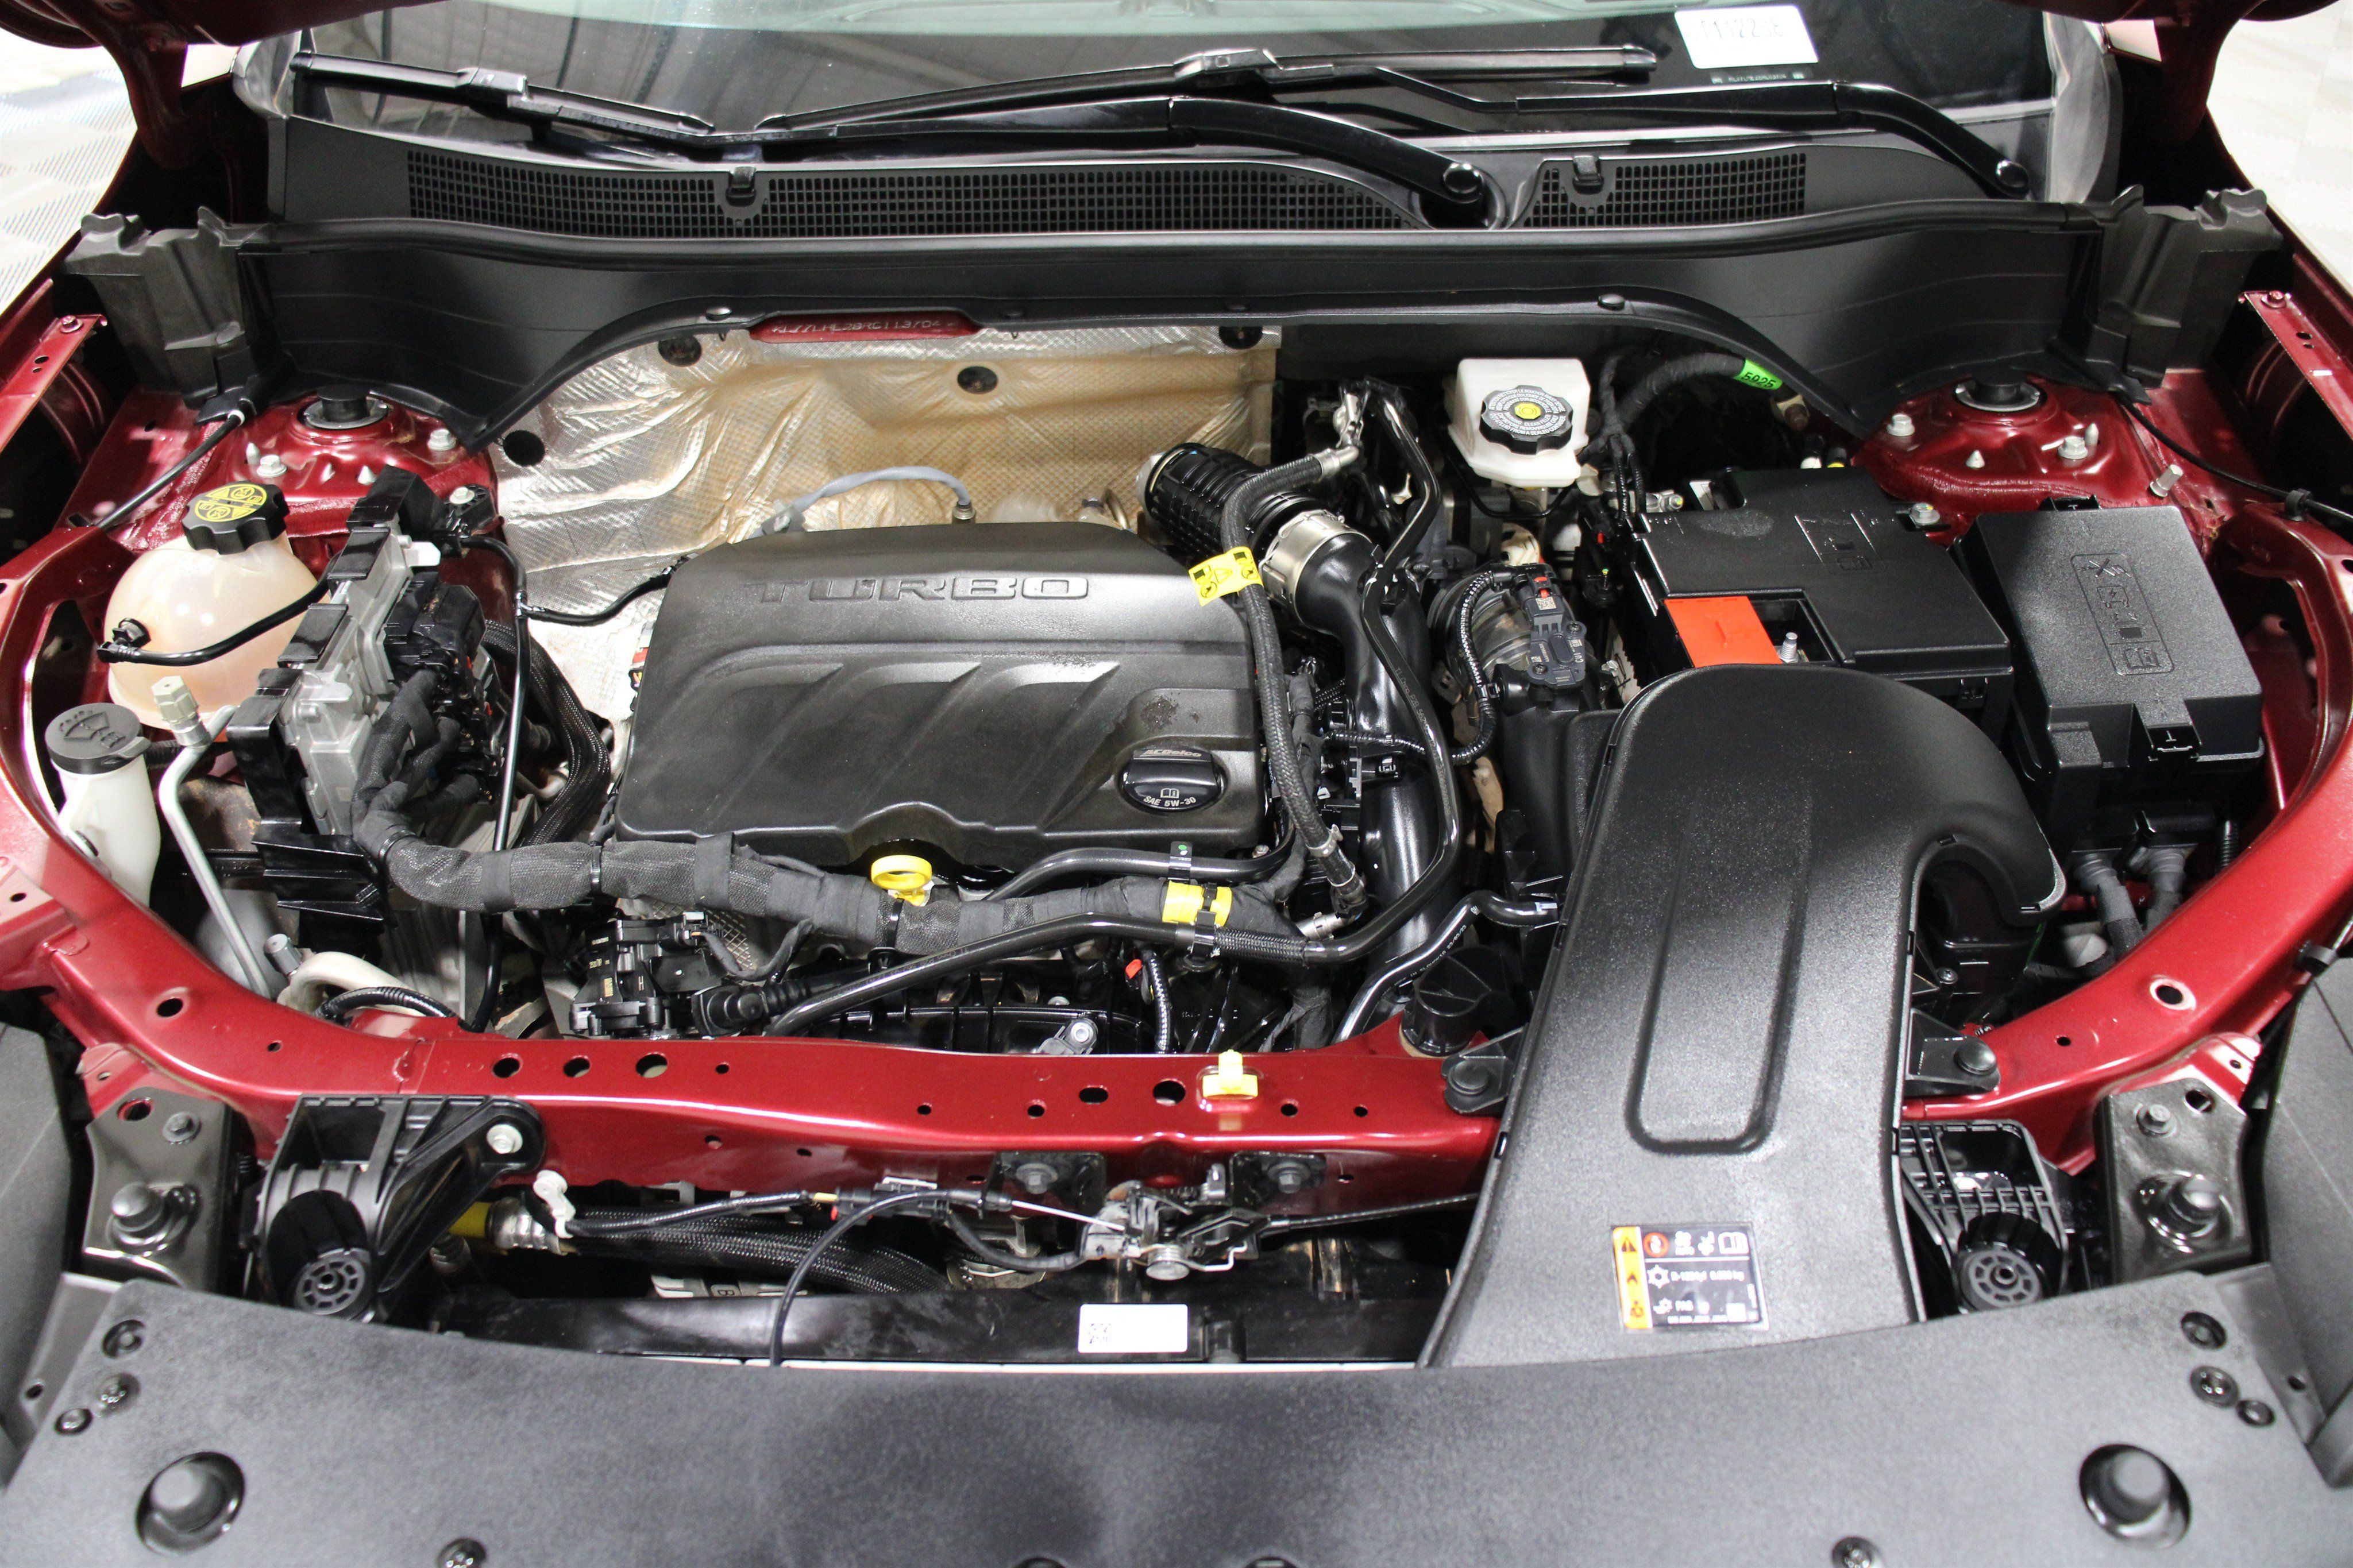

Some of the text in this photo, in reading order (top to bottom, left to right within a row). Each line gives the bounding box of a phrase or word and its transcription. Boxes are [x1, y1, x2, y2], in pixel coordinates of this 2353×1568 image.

[742, 576, 1090, 603] TURBO
[1140, 748, 1202, 757] ACDelco
[1143, 795, 1197, 807] SAE 5W-30
